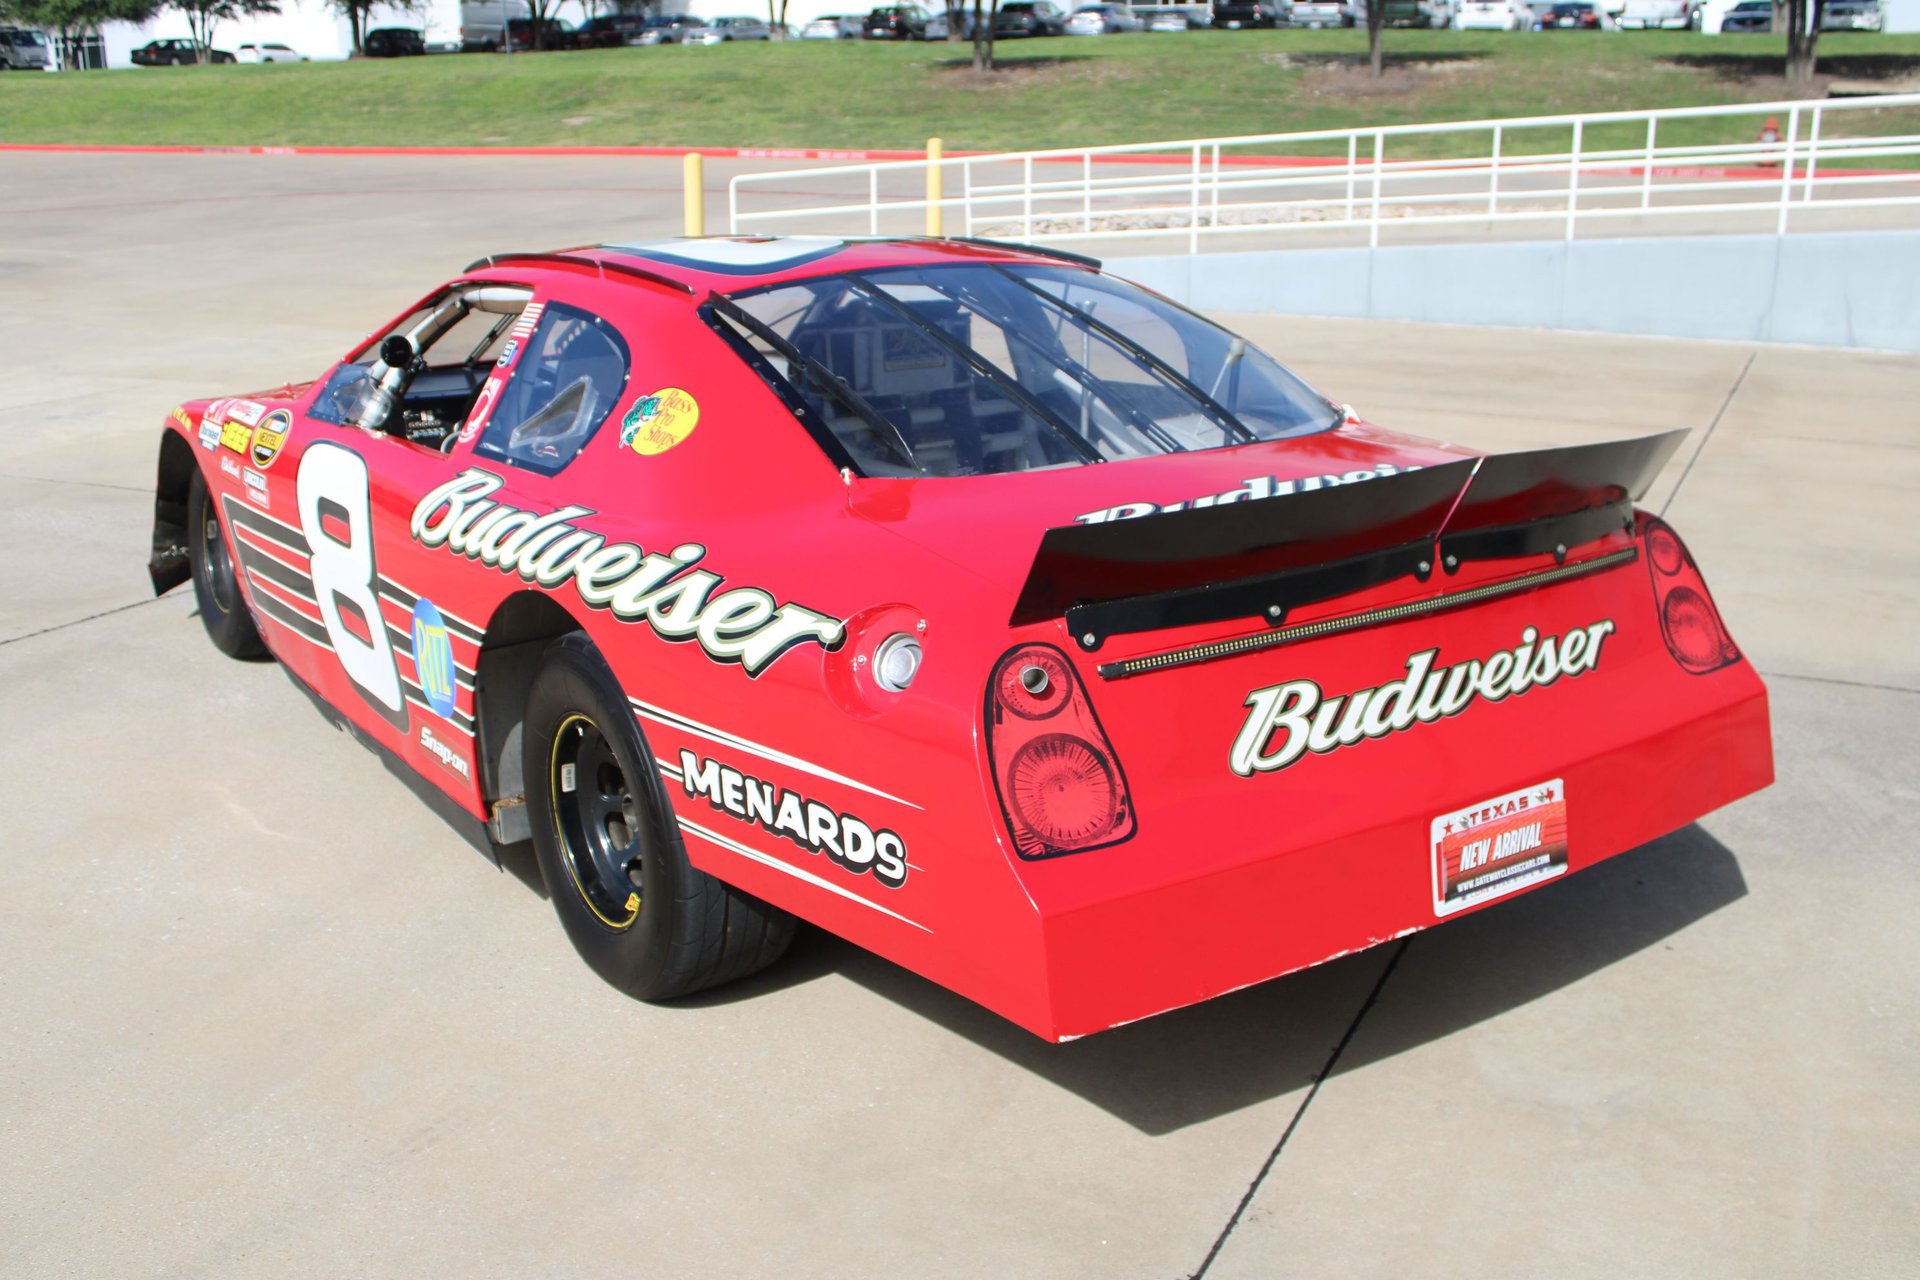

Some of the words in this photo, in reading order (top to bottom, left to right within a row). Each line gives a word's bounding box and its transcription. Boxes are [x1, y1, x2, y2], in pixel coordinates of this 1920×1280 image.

[654, 406, 676, 426] Pro
[662, 390, 695, 414] Bass
[643, 425, 680, 450] Shops
[296, 440, 408, 732] 8
[410, 466, 847, 679] Budweiser
[1229, 618, 1617, 779] Budweiser
[420, 726, 470, 780] Snap-on
[680, 748, 907, 888] MENARDS
[1469, 795, 1529, 826] TEXAS
[1460, 837, 1491, 872] NEW
[1492, 821, 1542, 862] ARRIVAL
